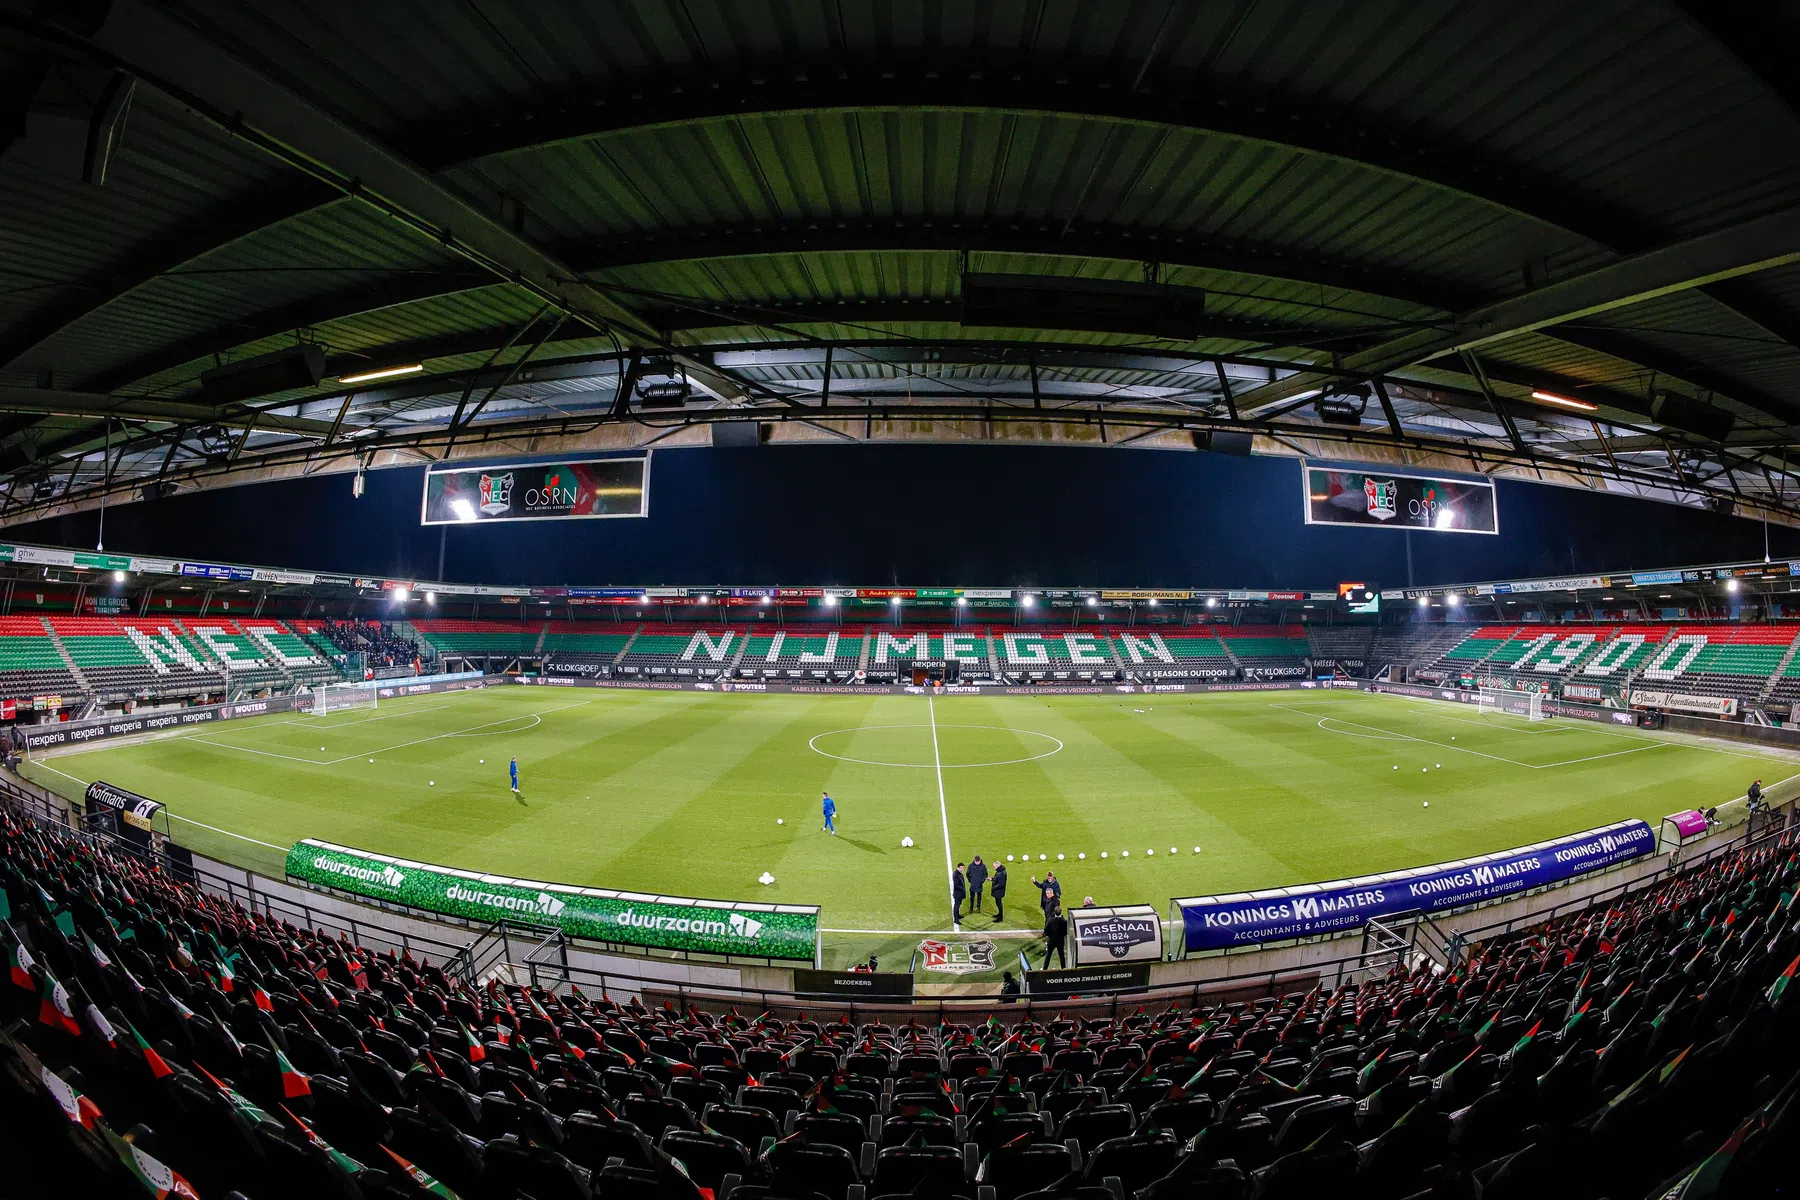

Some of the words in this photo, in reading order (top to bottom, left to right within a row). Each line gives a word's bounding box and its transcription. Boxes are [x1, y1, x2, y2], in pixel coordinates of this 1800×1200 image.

[483, 490, 508, 502] NEC
[525, 487, 577, 506] OSRN
[1370, 496, 1394, 508] NEC
[17, 549, 35, 560] ghw
[1656, 573, 1681, 581] TRANSPORT
[1555, 580, 1588, 588] KLOKGROEP
[85, 597, 97, 605] RON
[99, 598, 107, 606] DE
[108, 598, 128, 607] GROOT
[681, 630, 1176, 664] NIJMEGEN
[1510, 633, 1708, 680] 1900
[556, 664, 599, 673] KLOKGROEP
[912, 661, 946, 669] nexperia
[868, 671, 897, 679] nexperia
[961, 671, 990, 679] nexperia
[1190, 669, 1228, 677] OUTDOOR
[1265, 668, 1306, 676] KLOKGROEP
[548, 677, 575, 685] WOUTERS
[408, 684, 430, 692] WOUTERS
[1571, 686, 1601, 699] NIJMEGEN
[290, 699, 311, 708] KABELS
[1635, 692, 1656, 703] Sinds
[235, 702, 267, 714] WOUTERS
[1566, 707, 1599, 719] VRIJZUIGEN
[147, 716, 178, 728] nexperia
[183, 711, 212, 723] nexperia
[110, 720, 142, 734] nexperia
[29, 731, 65, 747] nexperia
[71, 726, 105, 741] nexperia
[88, 784, 127, 810] hofmans
[1554, 842, 1601, 864] KONINGS
[1615, 827, 1649, 848] MATERS
[1573, 857, 1609, 872] ACCOUNTANTS
[1613, 846, 1638, 860] ADVISEURS
[1409, 873, 1473, 897] KONINGS
[1493, 857, 1541, 881] MATERS
[1433, 889, 1482, 907] ACCOUNTANTS
[1490, 879, 1524, 893] ADVISEURS
[1204, 904, 1290, 928] KONINGS
[1321, 889, 1385, 913] MATERS
[1084, 923, 1152, 936] ARSENAAL
[1233, 924, 1301, 941] ACCOUNTANTS
[1305, 922, 1311, 931] &
[1314, 915, 1360, 929] ADVISEURS
[1108, 932, 1129, 940] 1824
[930, 952, 988, 963] NEC
